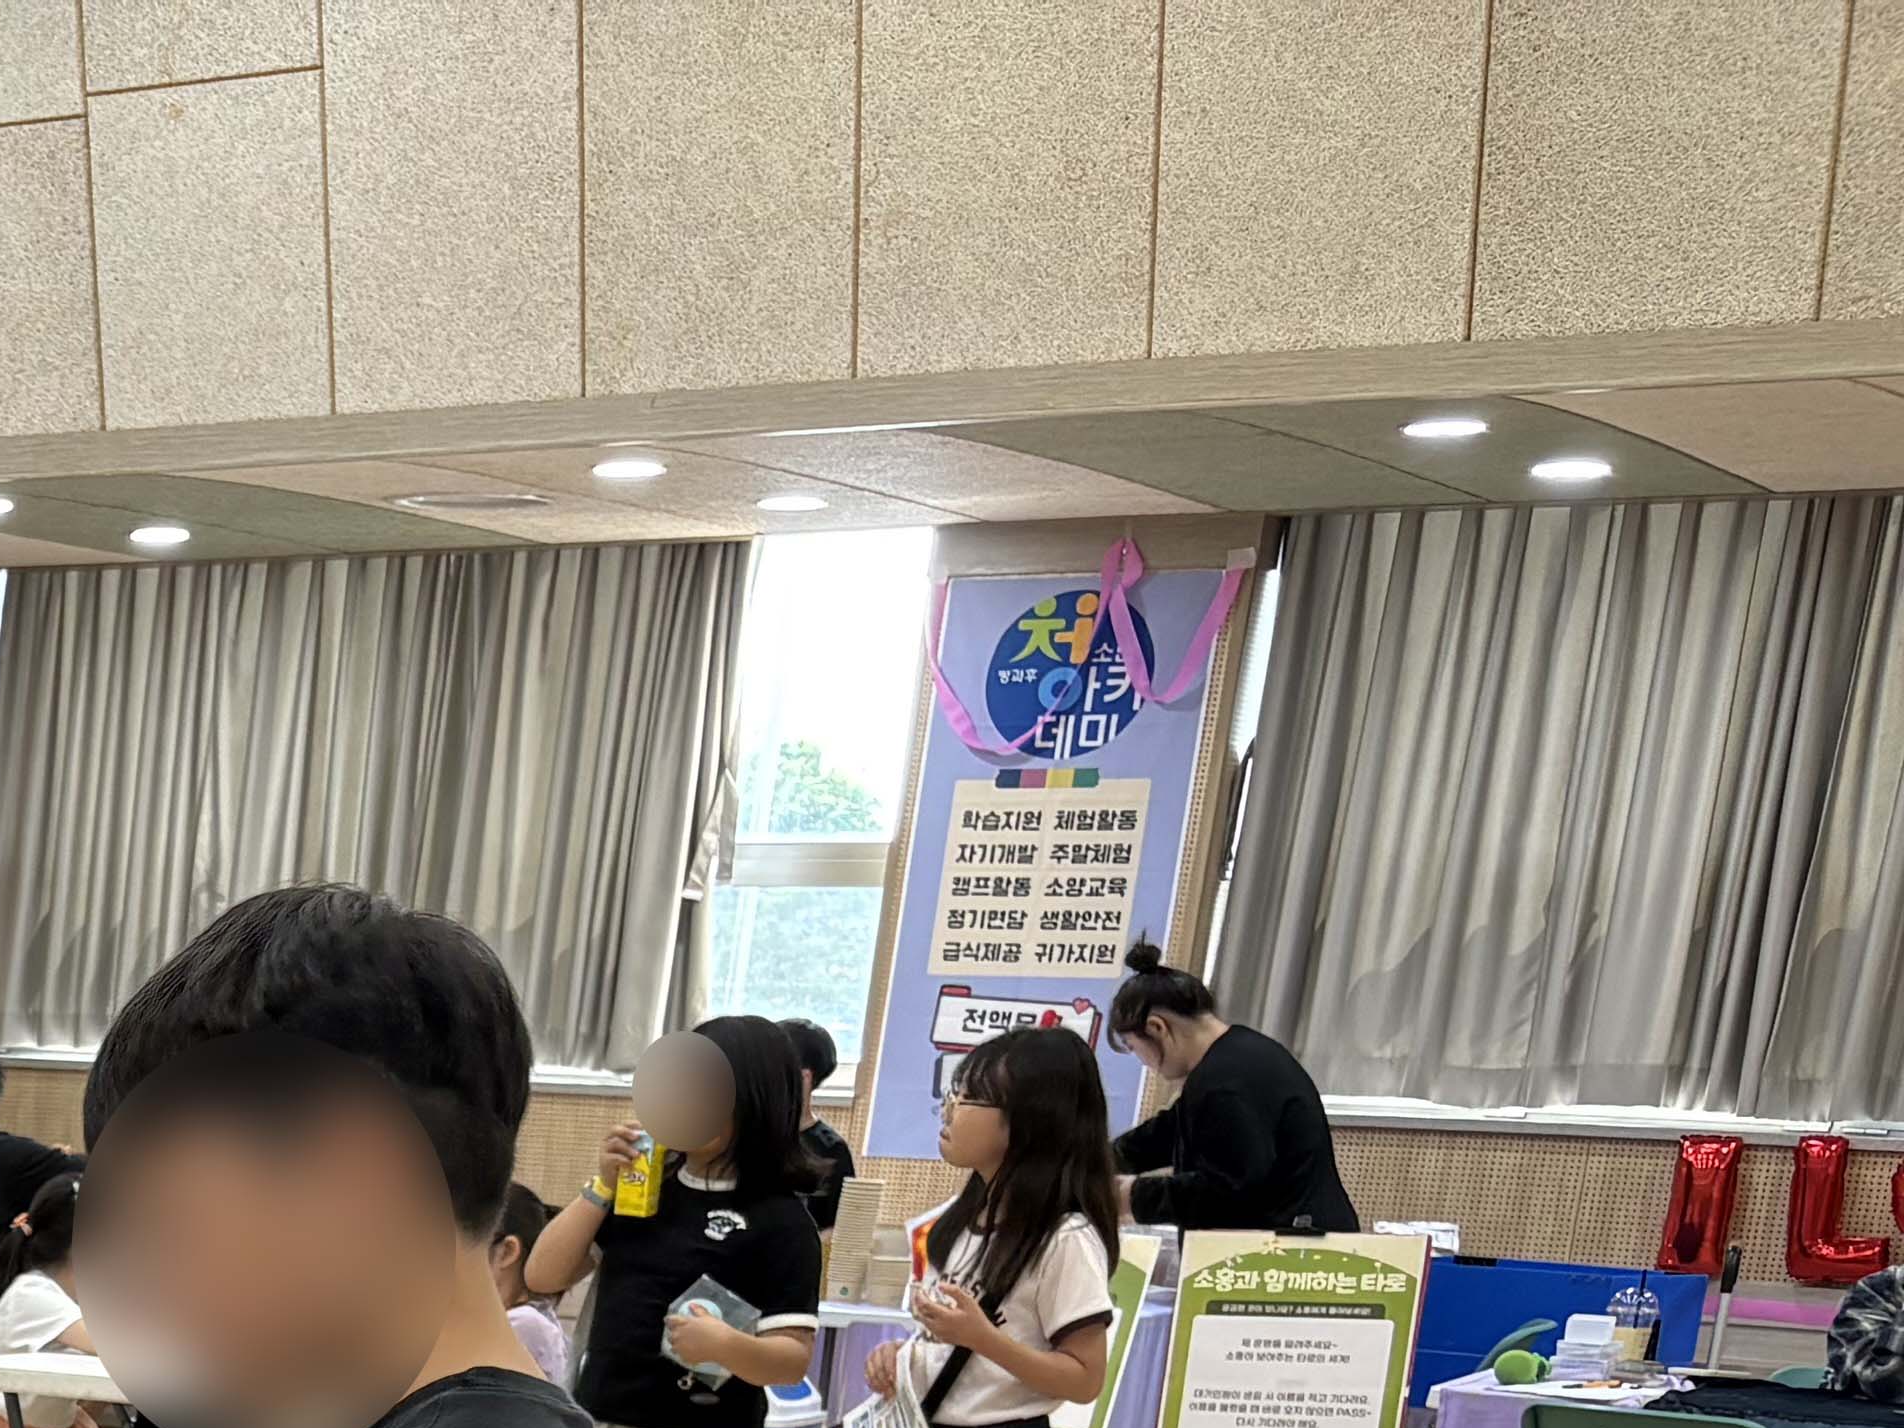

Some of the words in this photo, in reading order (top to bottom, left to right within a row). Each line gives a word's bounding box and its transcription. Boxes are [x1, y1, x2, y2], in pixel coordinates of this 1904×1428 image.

[962, 809, 1043, 833] 학습지원
[1054, 809, 1138, 832] 체험활동
[955, 843, 1038, 866] 자기개발
[1049, 843, 1132, 865] 주말체험
[952, 876, 1032, 898] 캠프활동
[1044, 877, 1128, 899] 소양교육
[947, 909, 1028, 931] 정기면담
[1040, 910, 1123, 932] 생활안전
[942, 942, 1023, 964] 급식제공
[1034, 943, 1116, 965] 귀가지원
[1263, 1268, 1359, 1294] 함께하는
[1360, 1272, 1407, 1293] 타로
[1189, 1401, 1217, 1413] 이름을
[1276, 1391, 1305, 1403] 이름을
[1235, 1417, 1255, 1428] 다시
